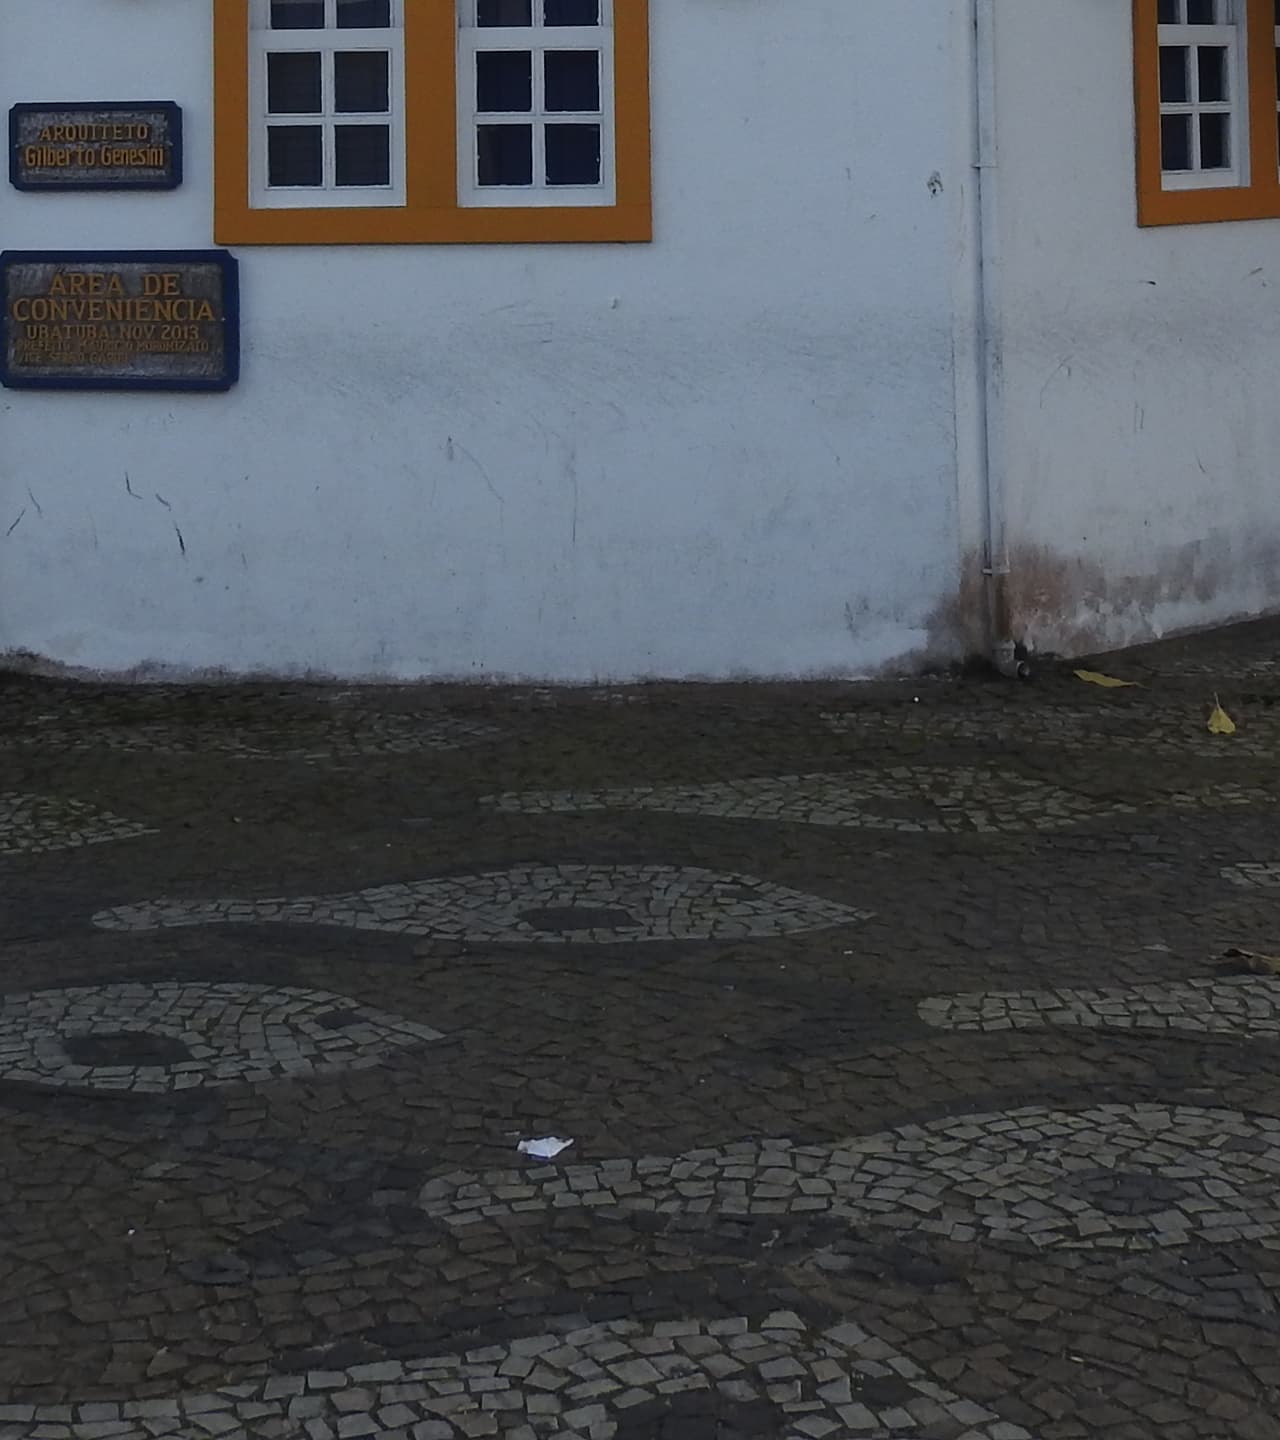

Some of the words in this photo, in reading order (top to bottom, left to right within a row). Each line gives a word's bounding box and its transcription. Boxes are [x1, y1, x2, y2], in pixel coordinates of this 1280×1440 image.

[39, 123, 149, 141] ARQUITETO
[24, 144, 96, 167] Gilberto
[101, 144, 164, 167] Genesini
[143, 273, 181, 296] DE
[160, 324, 199, 340] 2013
